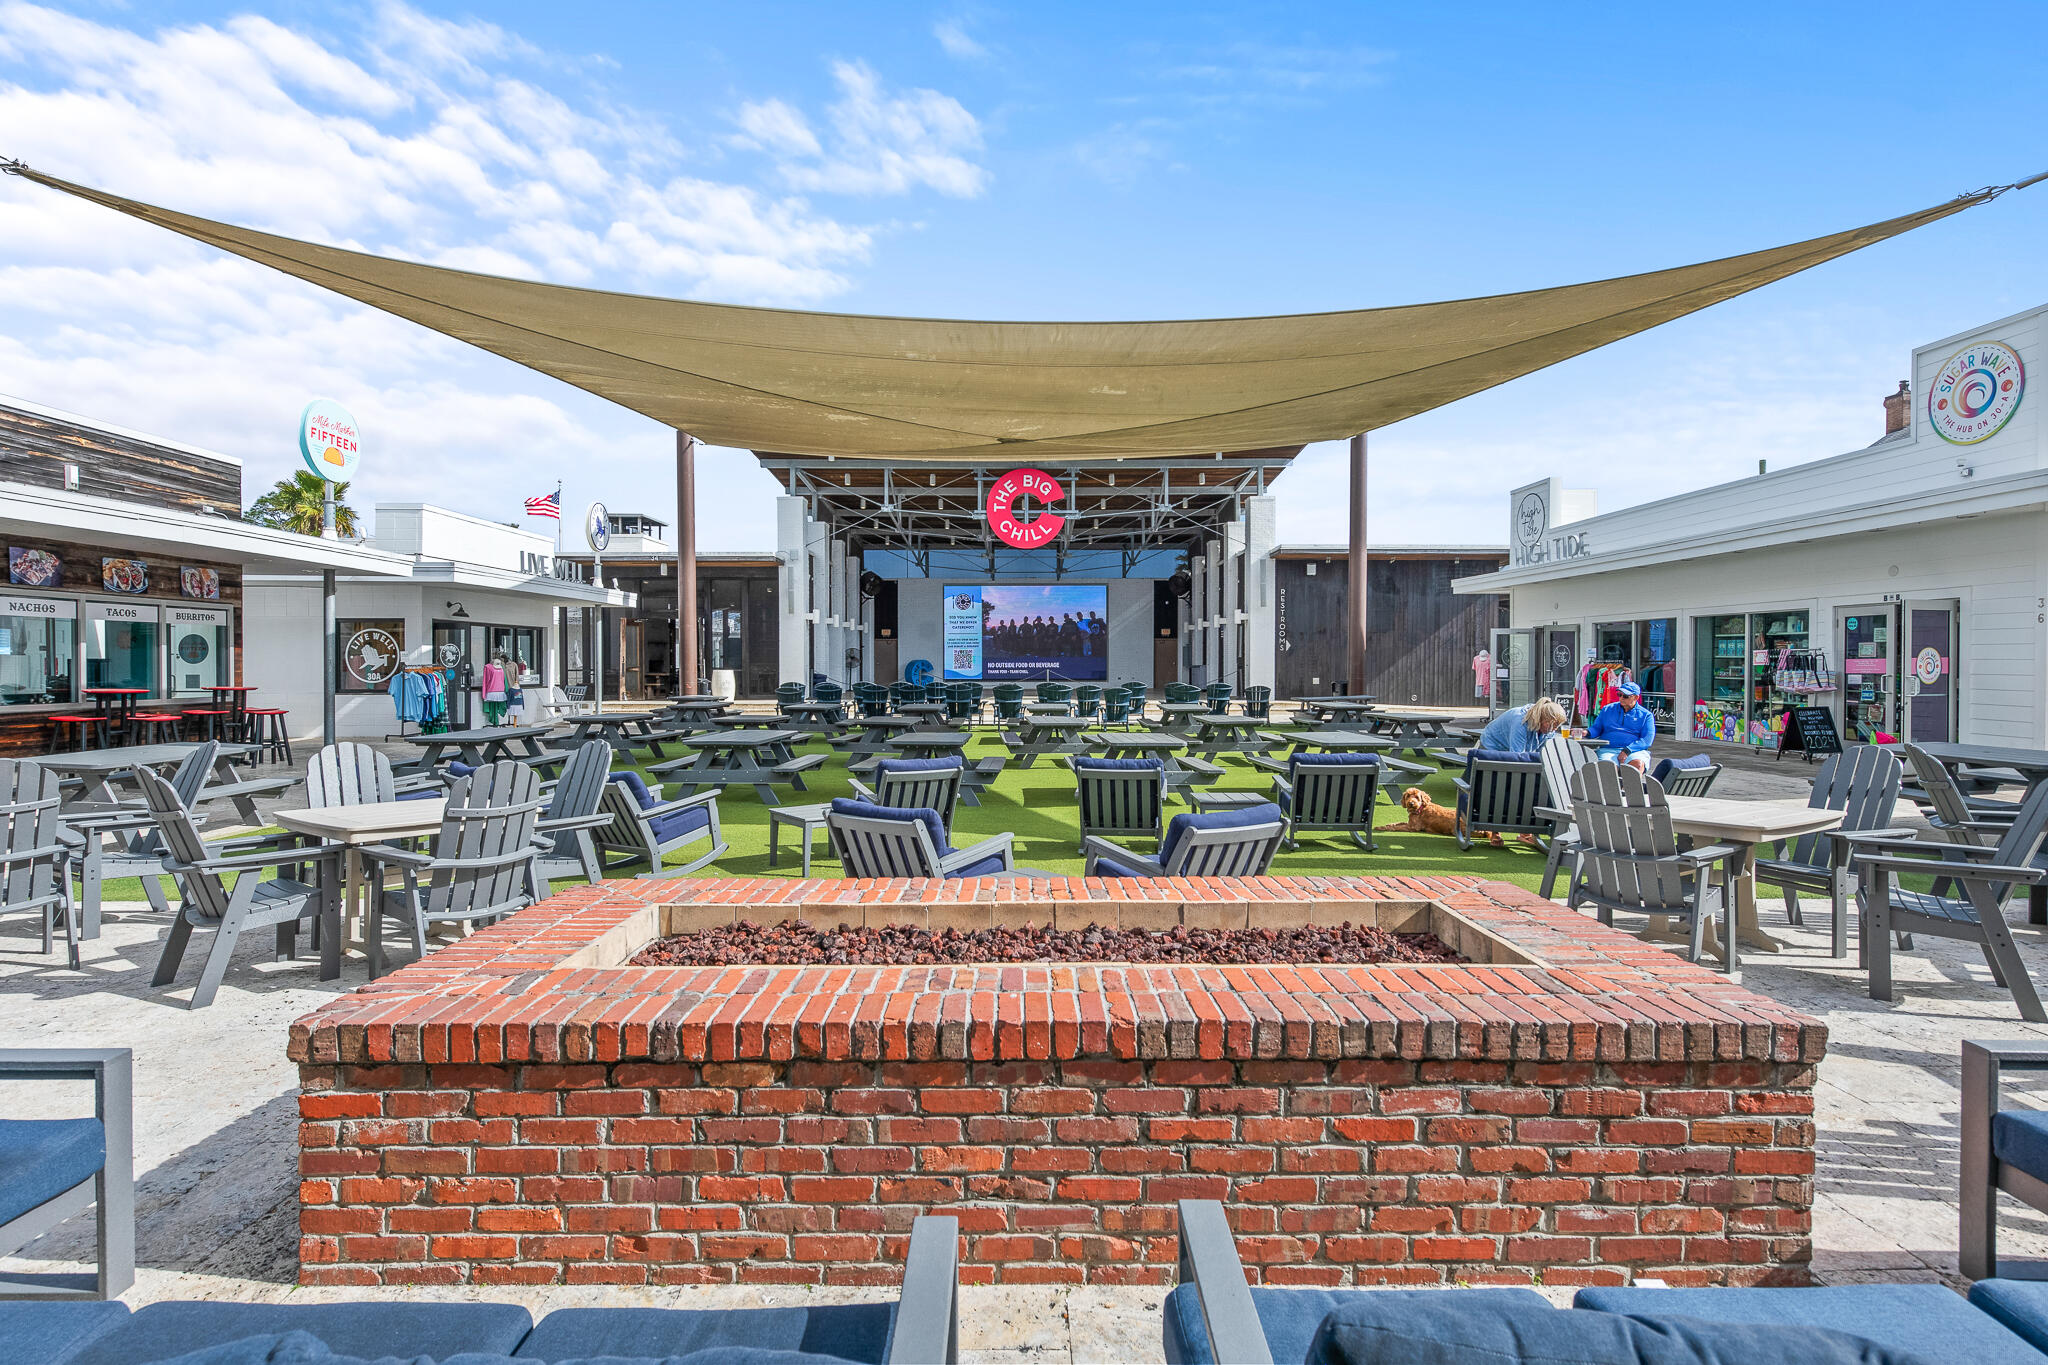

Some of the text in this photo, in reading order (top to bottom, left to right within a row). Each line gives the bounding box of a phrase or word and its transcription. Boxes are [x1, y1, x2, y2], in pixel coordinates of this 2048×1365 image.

[1940, 351, 2011, 393] SUGAR WAVE
[1943, 396, 2009, 433] THE HUB ON 30-A
[310, 426, 357, 453] FIFTEEN
[993, 474, 1052, 513] THE BIG
[1520, 499, 1542, 522] high
[999, 520, 1053, 542] CHILL
[1514, 531, 1591, 567] HIGH TIDE
[519, 550, 550, 577] LIVE
[9, 602, 56, 614] NACHOS
[105, 607, 137, 618] TACOS
[175, 612, 216, 622] BURRITOS
[1279, 588, 1287, 651] RESTROOMS
[350, 632, 396, 650] LIVE WELL
[367, 672, 381, 681] 30A
[1806, 735, 1837, 749] 2024
